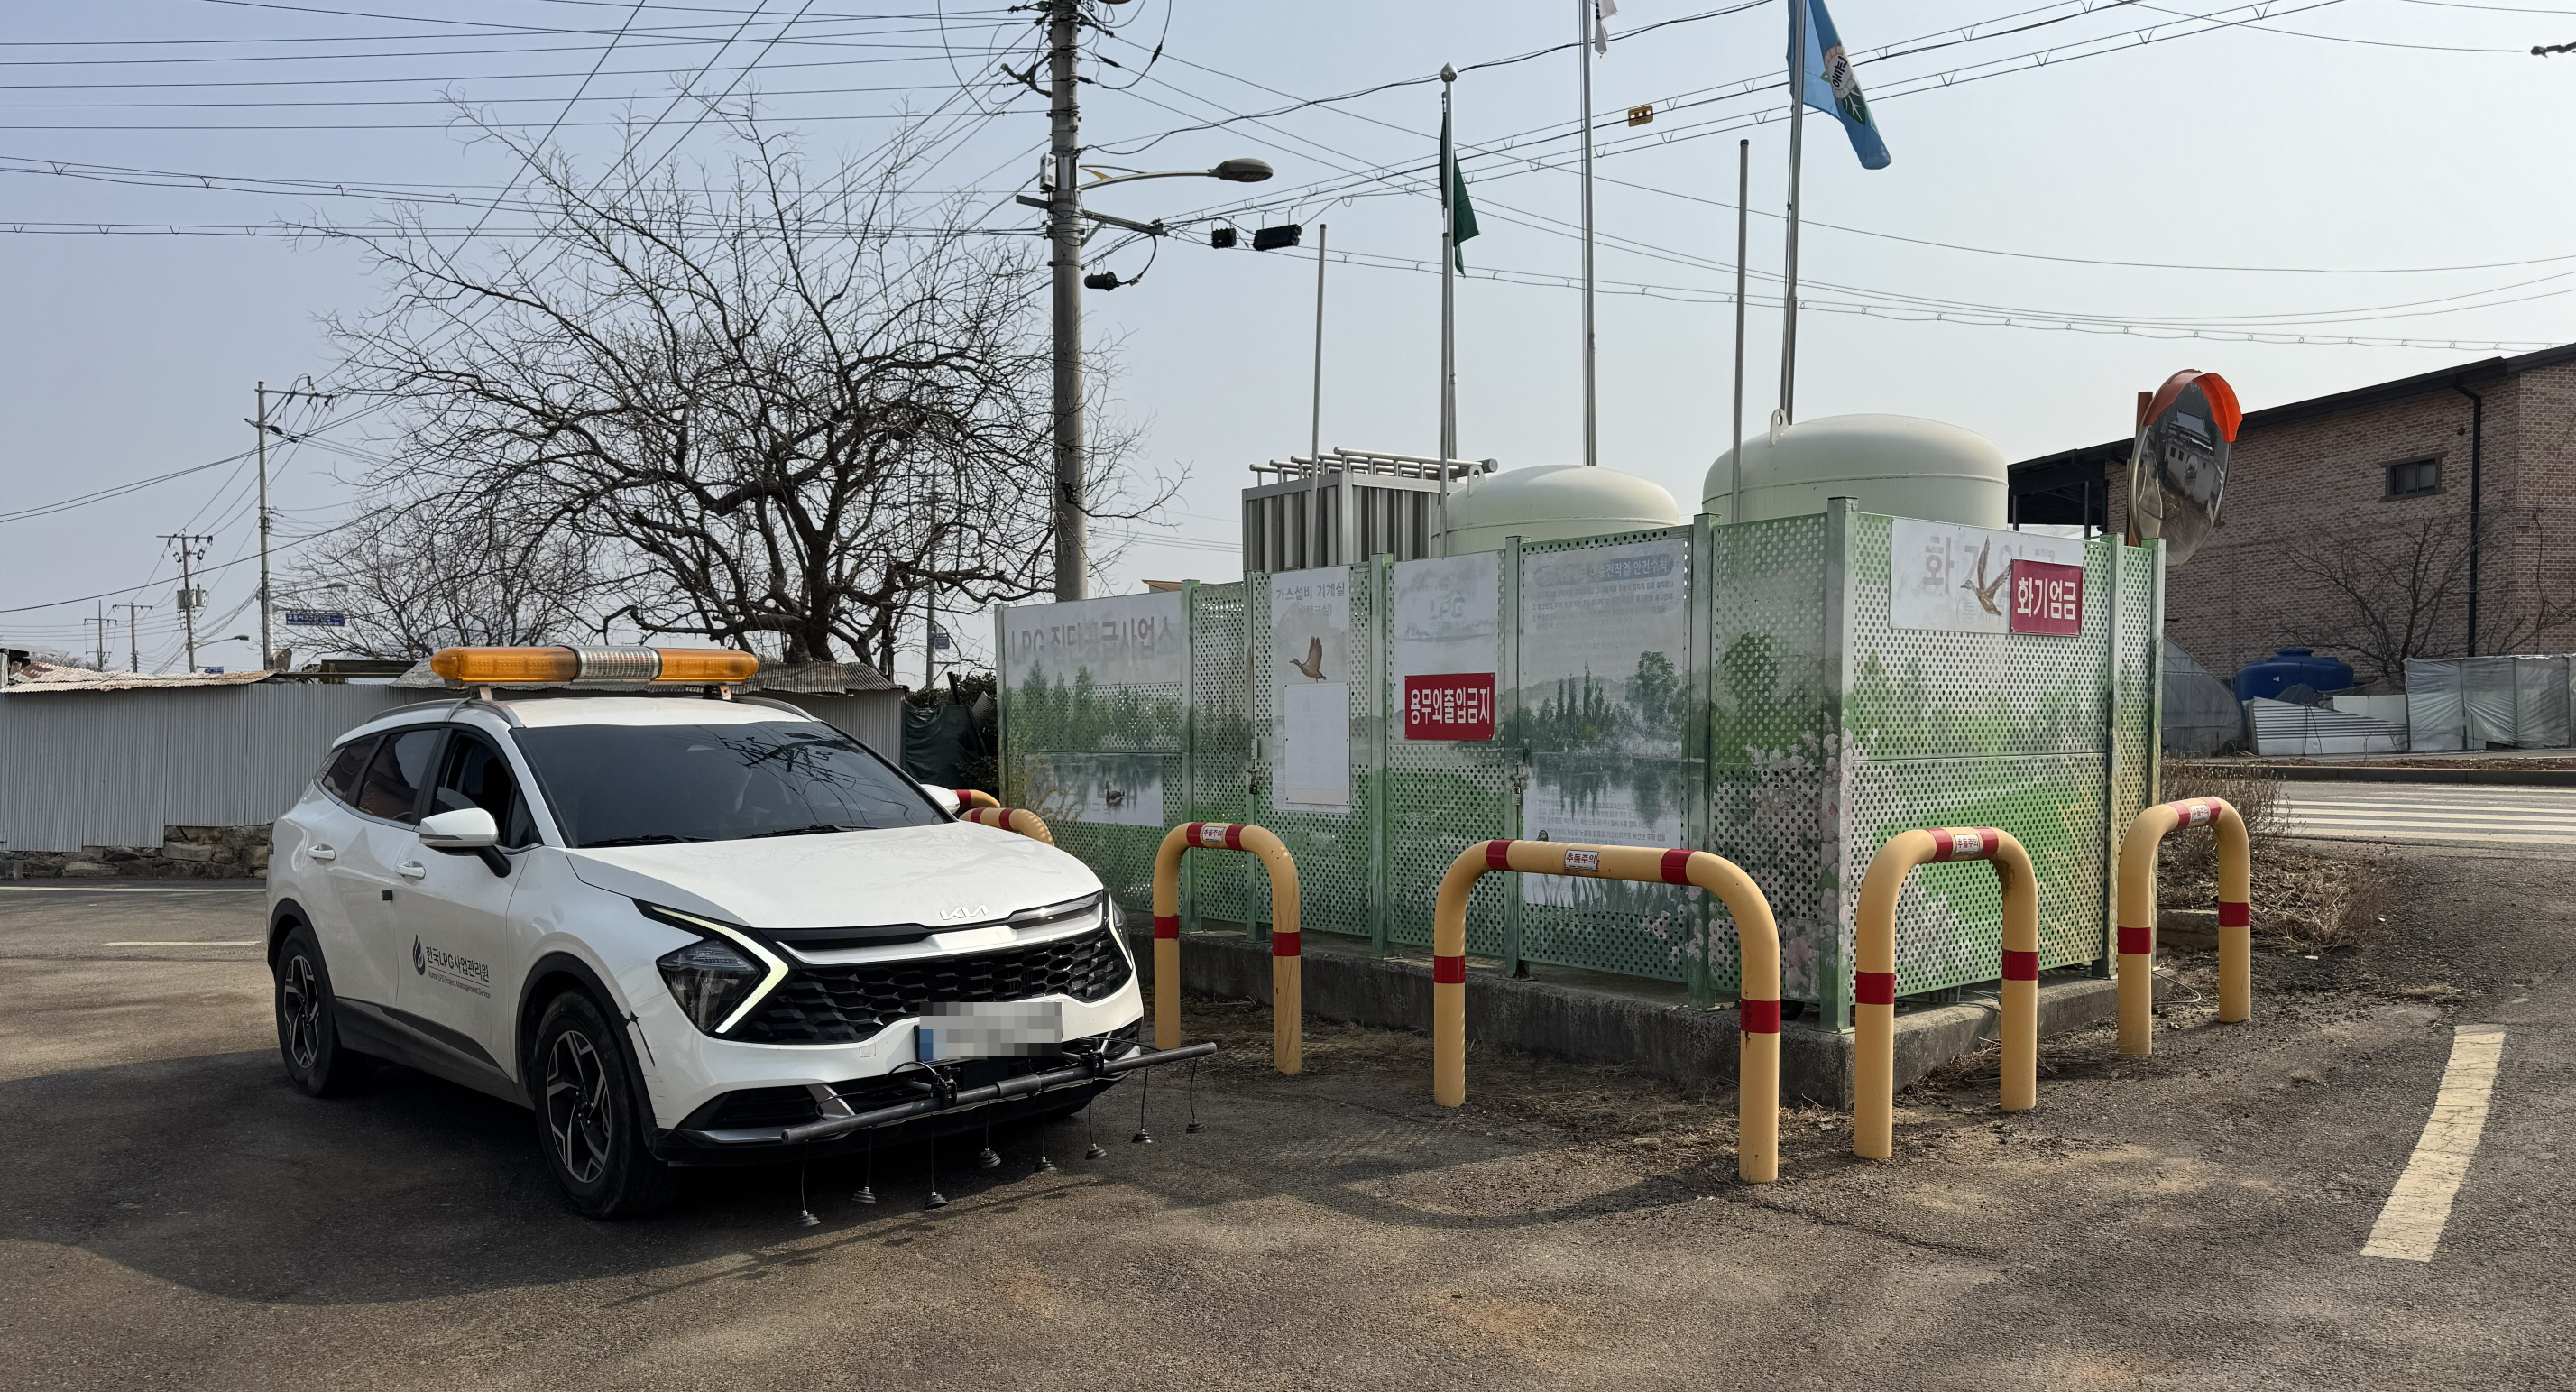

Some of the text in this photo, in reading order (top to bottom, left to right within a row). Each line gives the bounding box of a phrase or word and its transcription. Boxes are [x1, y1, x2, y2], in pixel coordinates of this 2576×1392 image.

[1633, 558, 1667, 575] 안전수칙
[1275, 582, 1345, 602] 가스설비 기계실
[2017, 577, 2077, 620] 화기엄금
[1409, 687, 1491, 724] 용무외출입금지
[1566, 853, 1596, 864] 추돌주의
